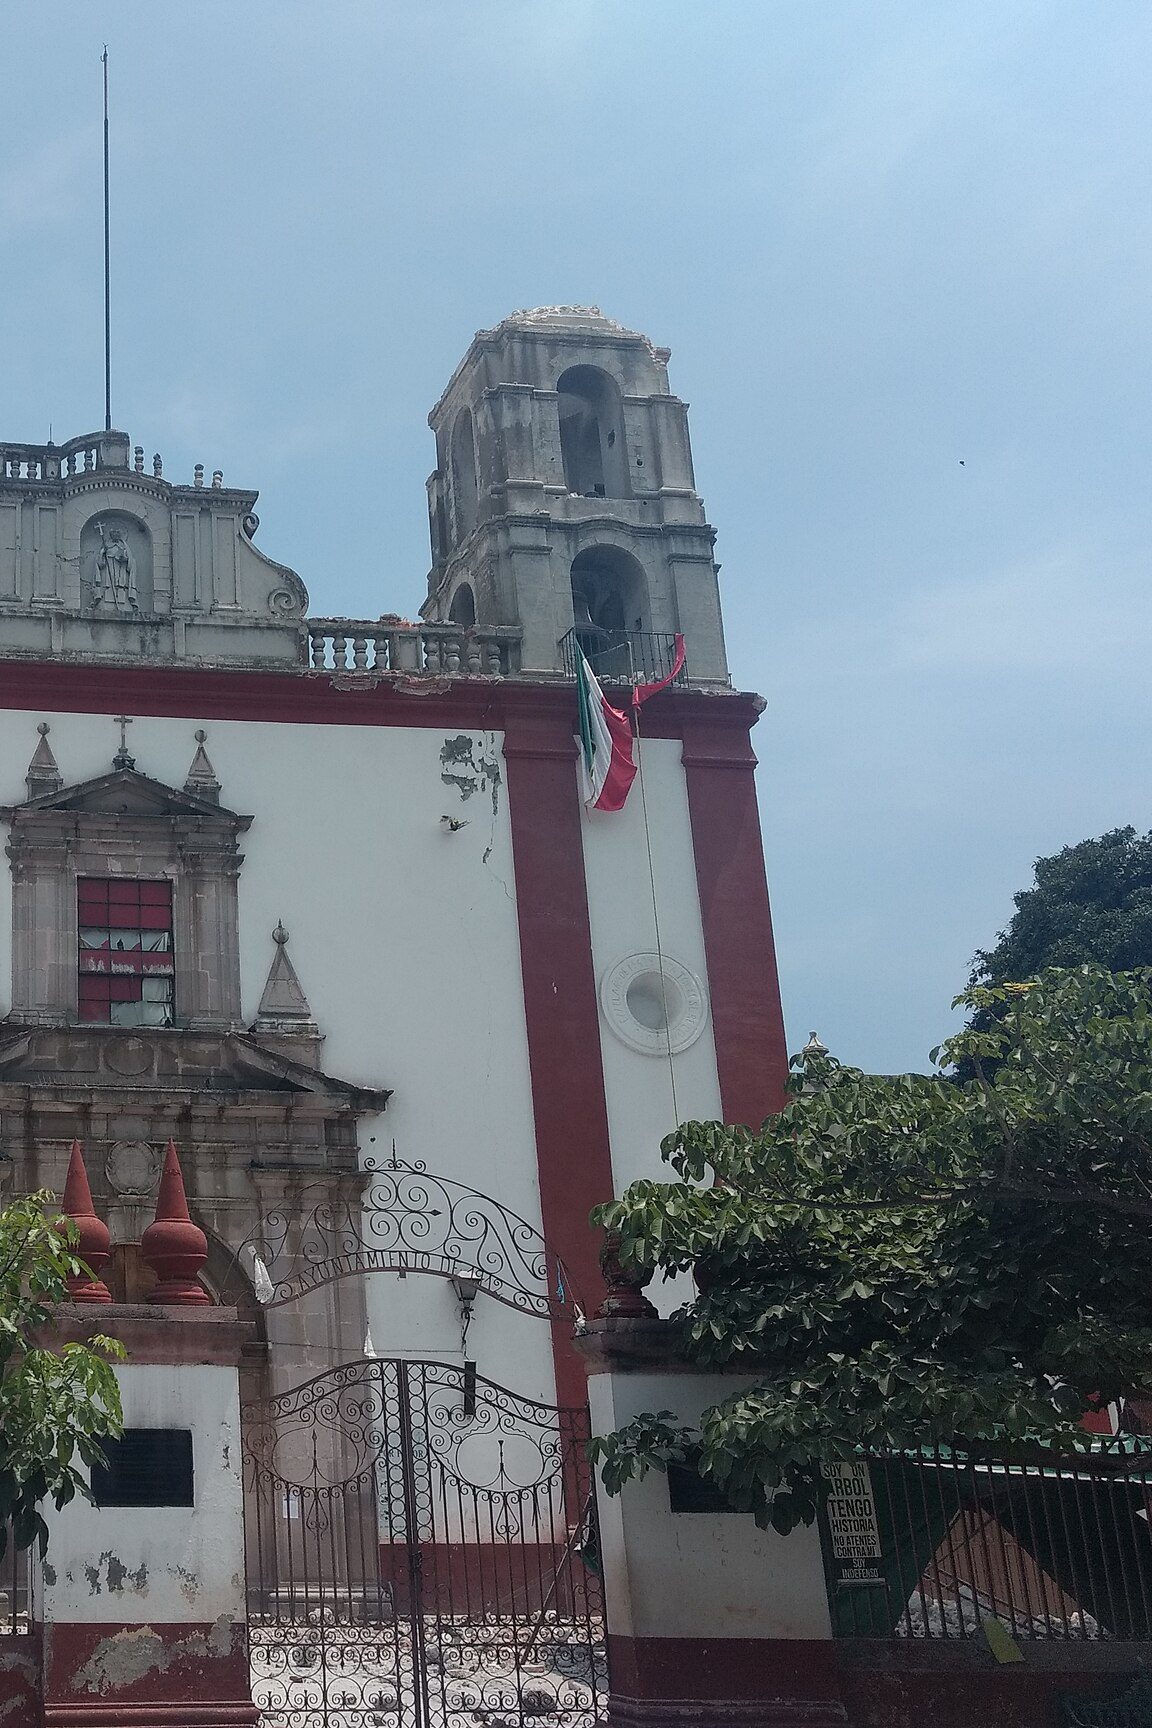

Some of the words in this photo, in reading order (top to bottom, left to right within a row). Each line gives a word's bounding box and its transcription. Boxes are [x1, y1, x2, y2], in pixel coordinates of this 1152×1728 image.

[298, 1251, 430, 1291] AYUNTAMIENTO
[441, 1257, 460, 1276] DE
[824, 1464, 842, 1477] SOY
[851, 1464, 865, 1477] UN
[828, 1499, 872, 1518] TENGO
[832, 1519, 875, 1533] HISTORIA
[834, 1536, 844, 1546] NO
[846, 1535, 876, 1545] ATENTES
[837, 1547, 866, 1557] CONTRA
[852, 1558, 866, 1568] SOY
